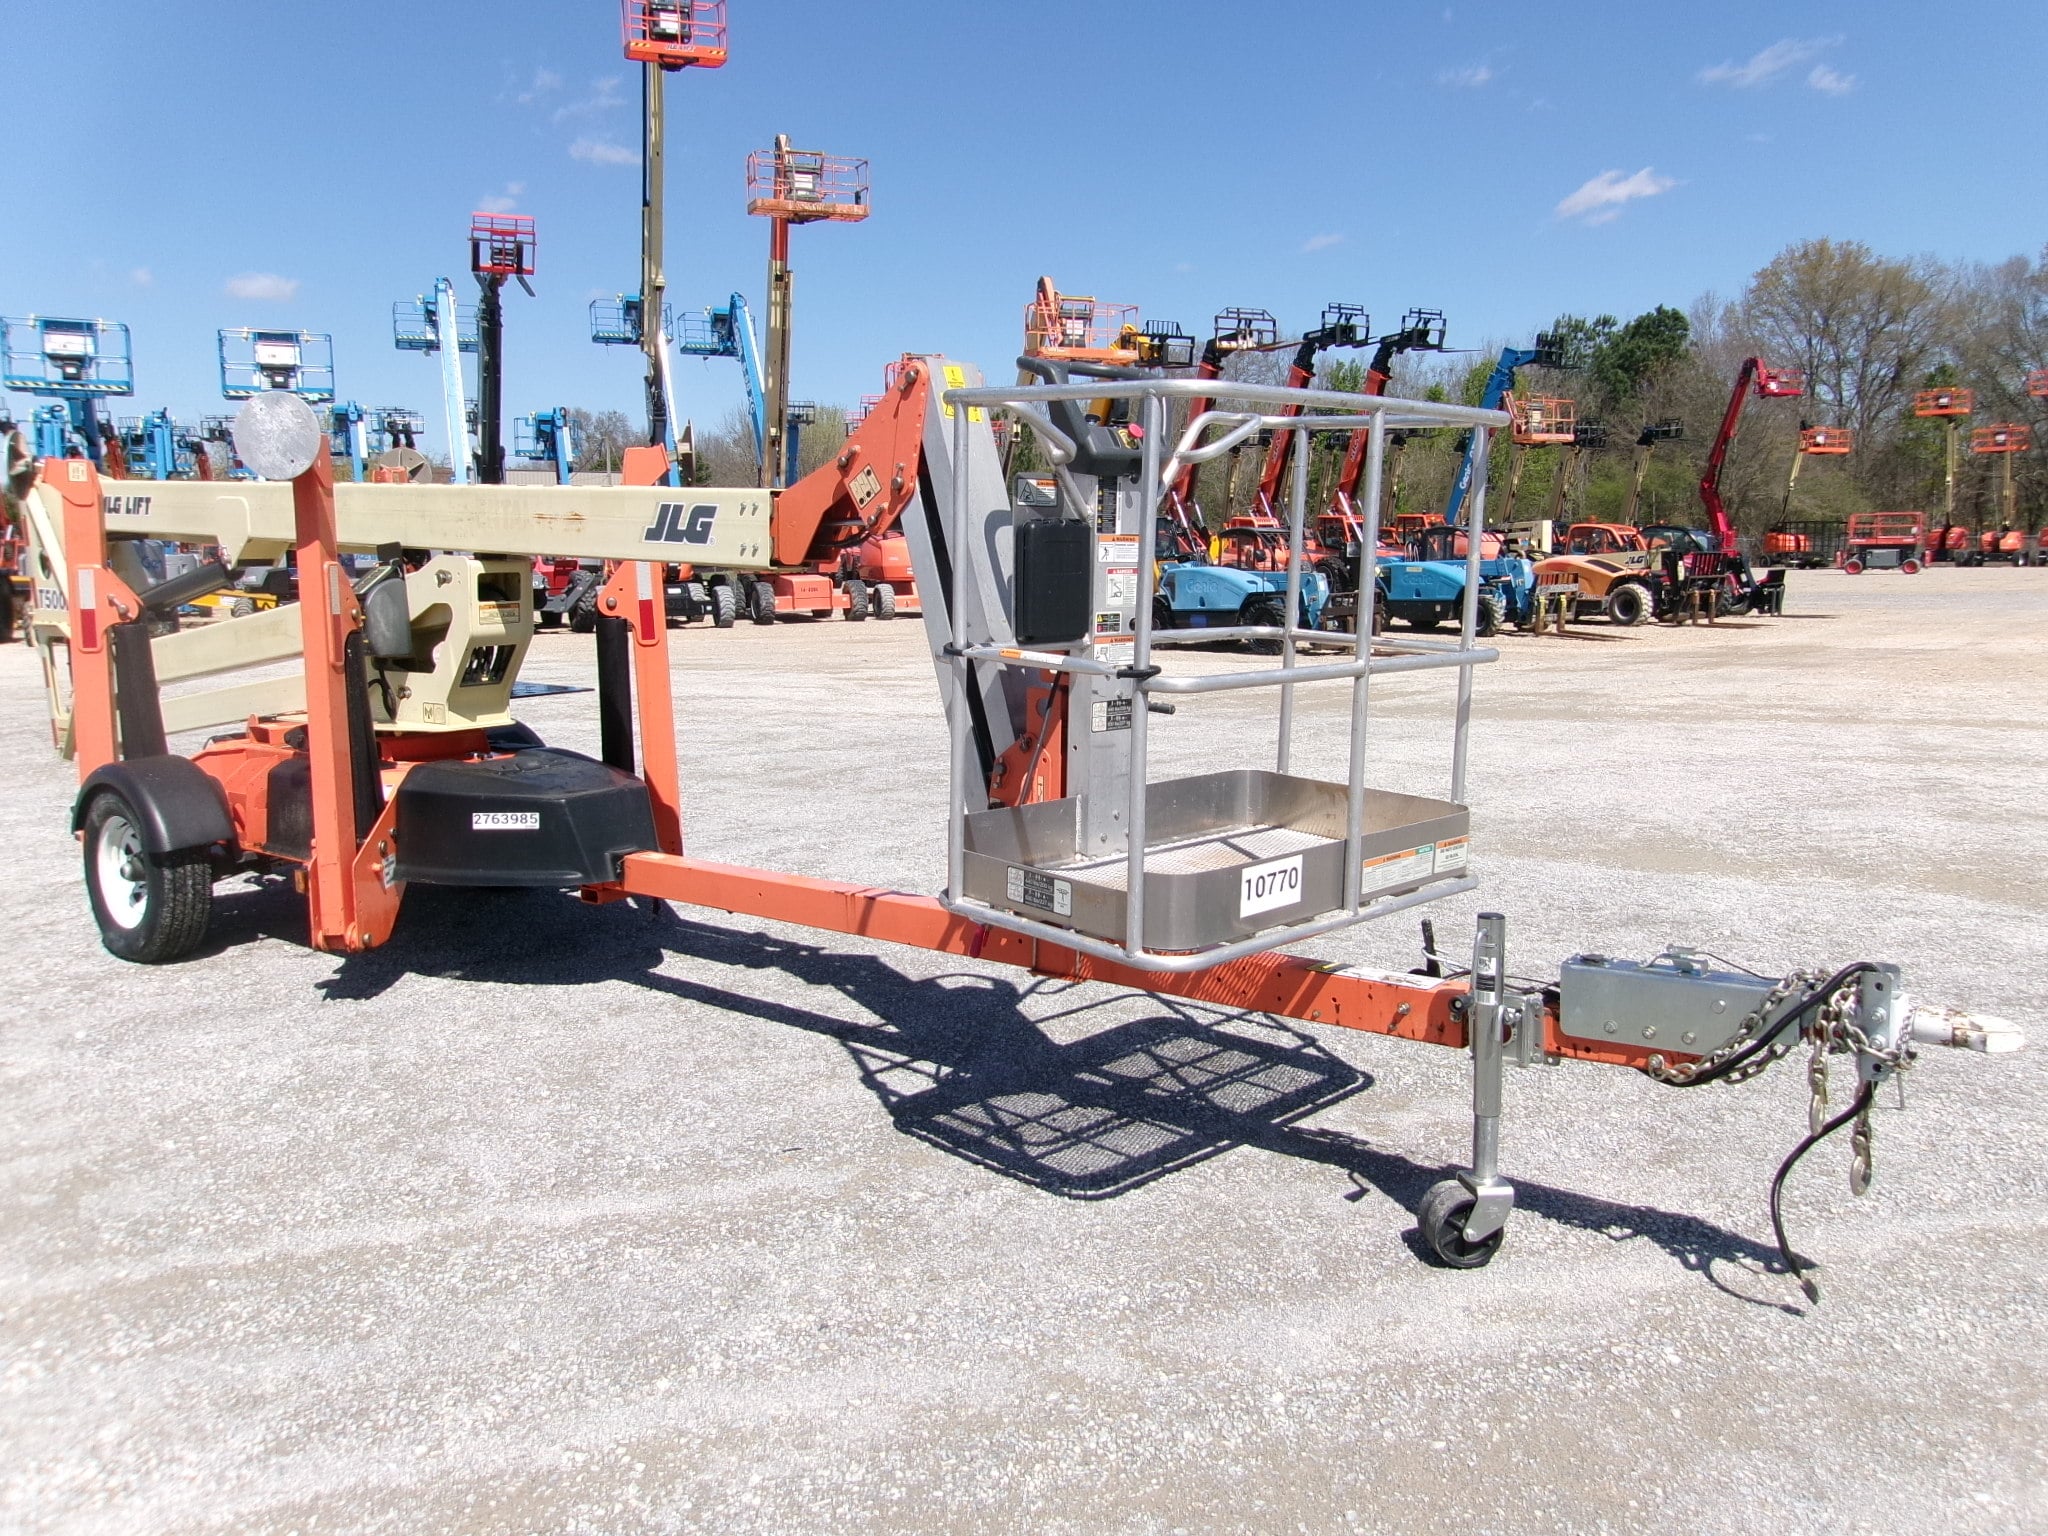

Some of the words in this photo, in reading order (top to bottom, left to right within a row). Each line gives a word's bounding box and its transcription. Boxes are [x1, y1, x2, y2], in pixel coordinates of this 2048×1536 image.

[125, 496, 152, 515] LIFT
[644, 503, 718, 545] JLG
[473, 813, 538, 825] 2763985
[1245, 866, 1299, 901] 10770
